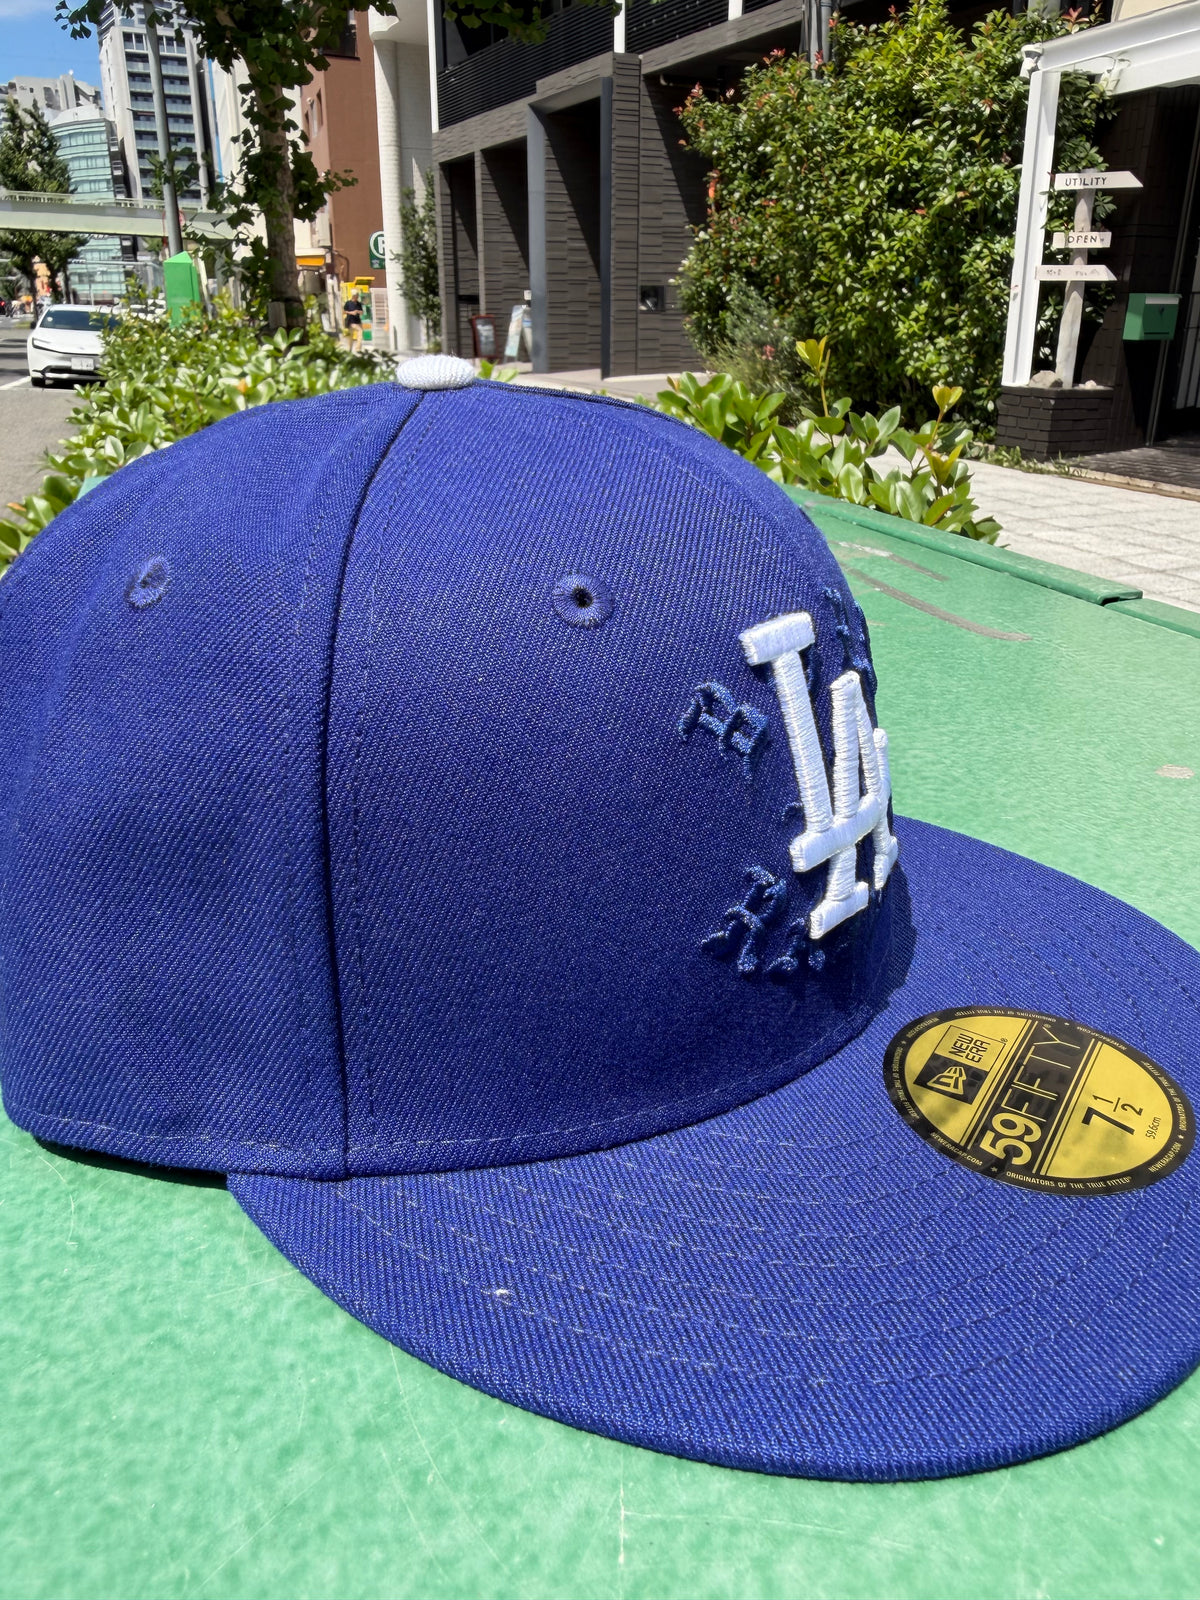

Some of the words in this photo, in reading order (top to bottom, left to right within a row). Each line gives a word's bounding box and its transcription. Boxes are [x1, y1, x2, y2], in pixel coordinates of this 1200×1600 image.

[1065, 177, 1107, 186] UTILITY
[1067, 235, 1098, 244] OPEN
[948, 1033, 974, 1058] NEW
[965, 1039, 991, 1063] ERA
[979, 1024, 1081, 1166] 59FIFTY
[1081, 1106, 1136, 1136] 7
[1145, 1116, 1162, 1139] 59.6cm
[930, 1132, 983, 1166] NEWERACAP.COM
[1006, 1171, 1055, 1187] ORIGINATORS
[1086, 1181, 1106, 1189] TRUE
